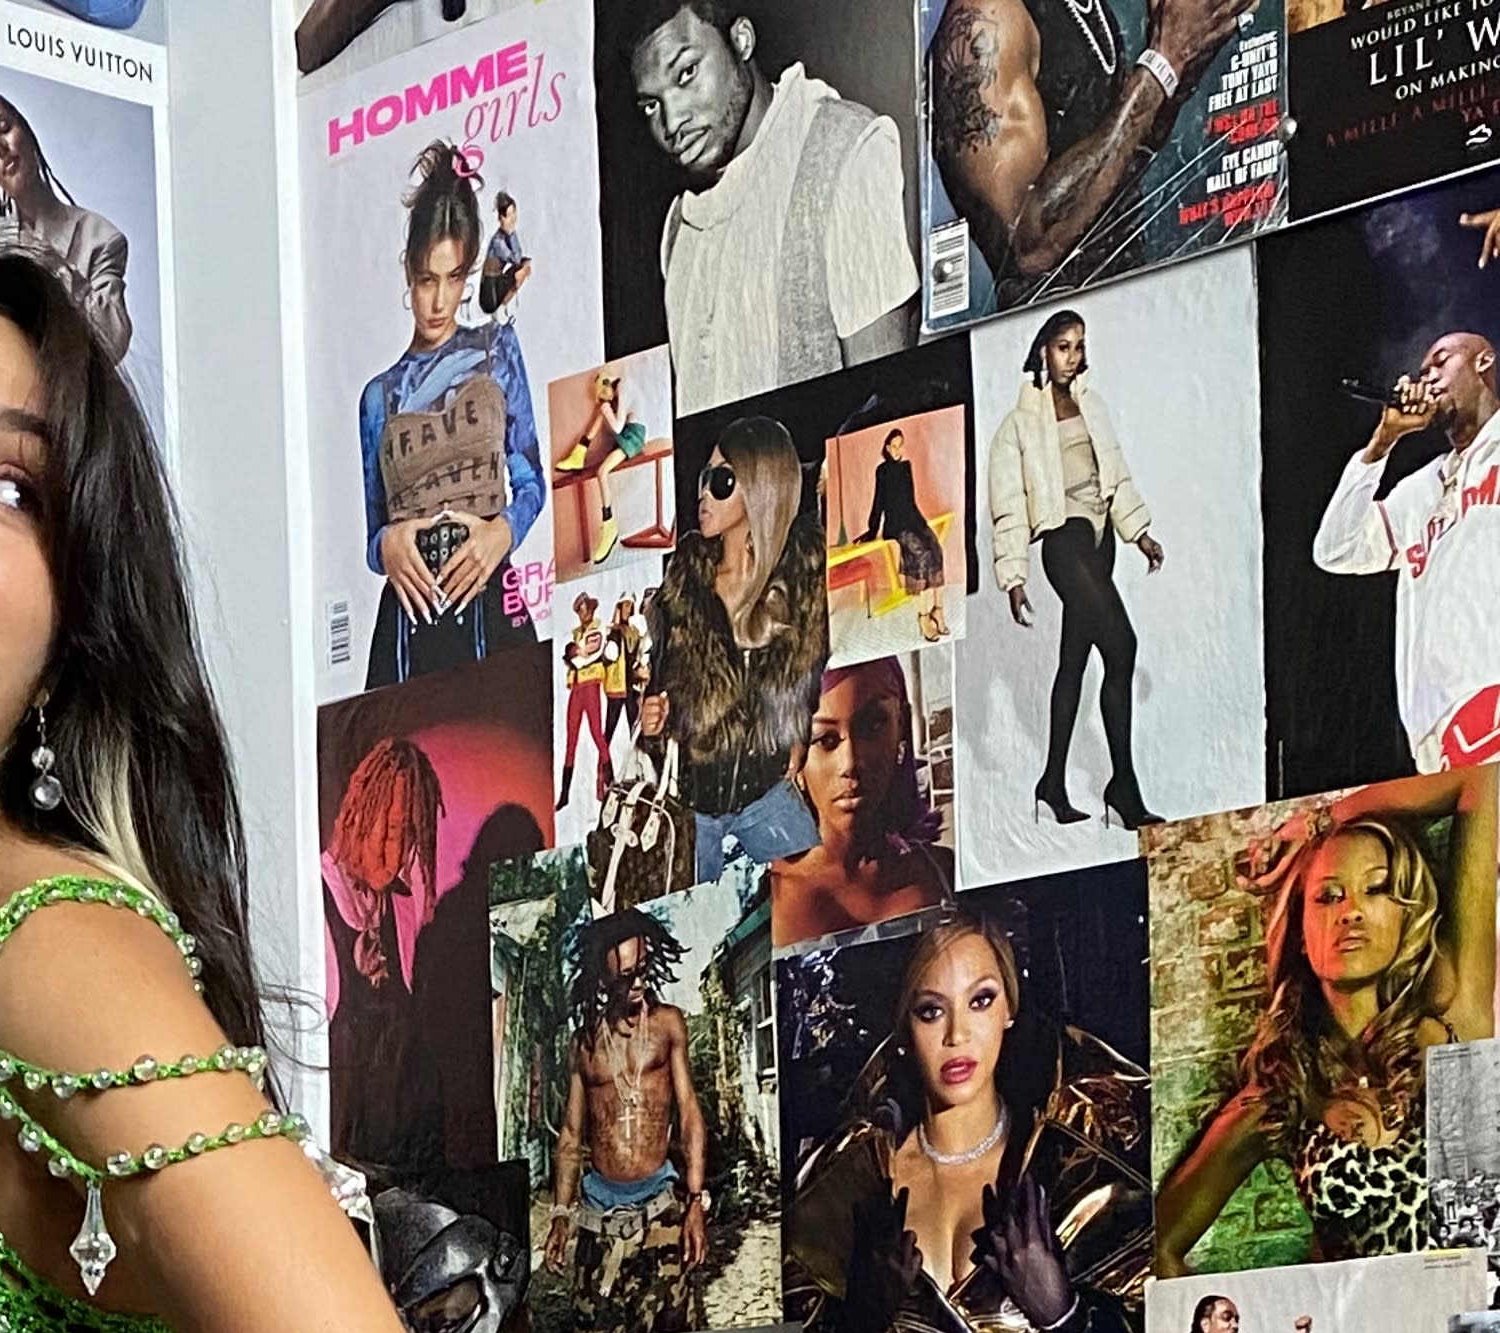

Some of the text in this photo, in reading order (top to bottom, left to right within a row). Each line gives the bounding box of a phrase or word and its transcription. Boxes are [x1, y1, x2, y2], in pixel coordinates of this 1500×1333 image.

[7, 23, 153, 83] LOUIS VUITTON
[1350, 18, 1417, 50] WOULD
[1423, 2, 1461, 27] LIKE
[1369, 28, 1444, 86] LIL'
[327, 40, 529, 156] HOMME
[454, 51, 568, 178] girls
[1207, 75, 1279, 113] FREE AT LAST
[1395, 79, 1423, 100] ON
